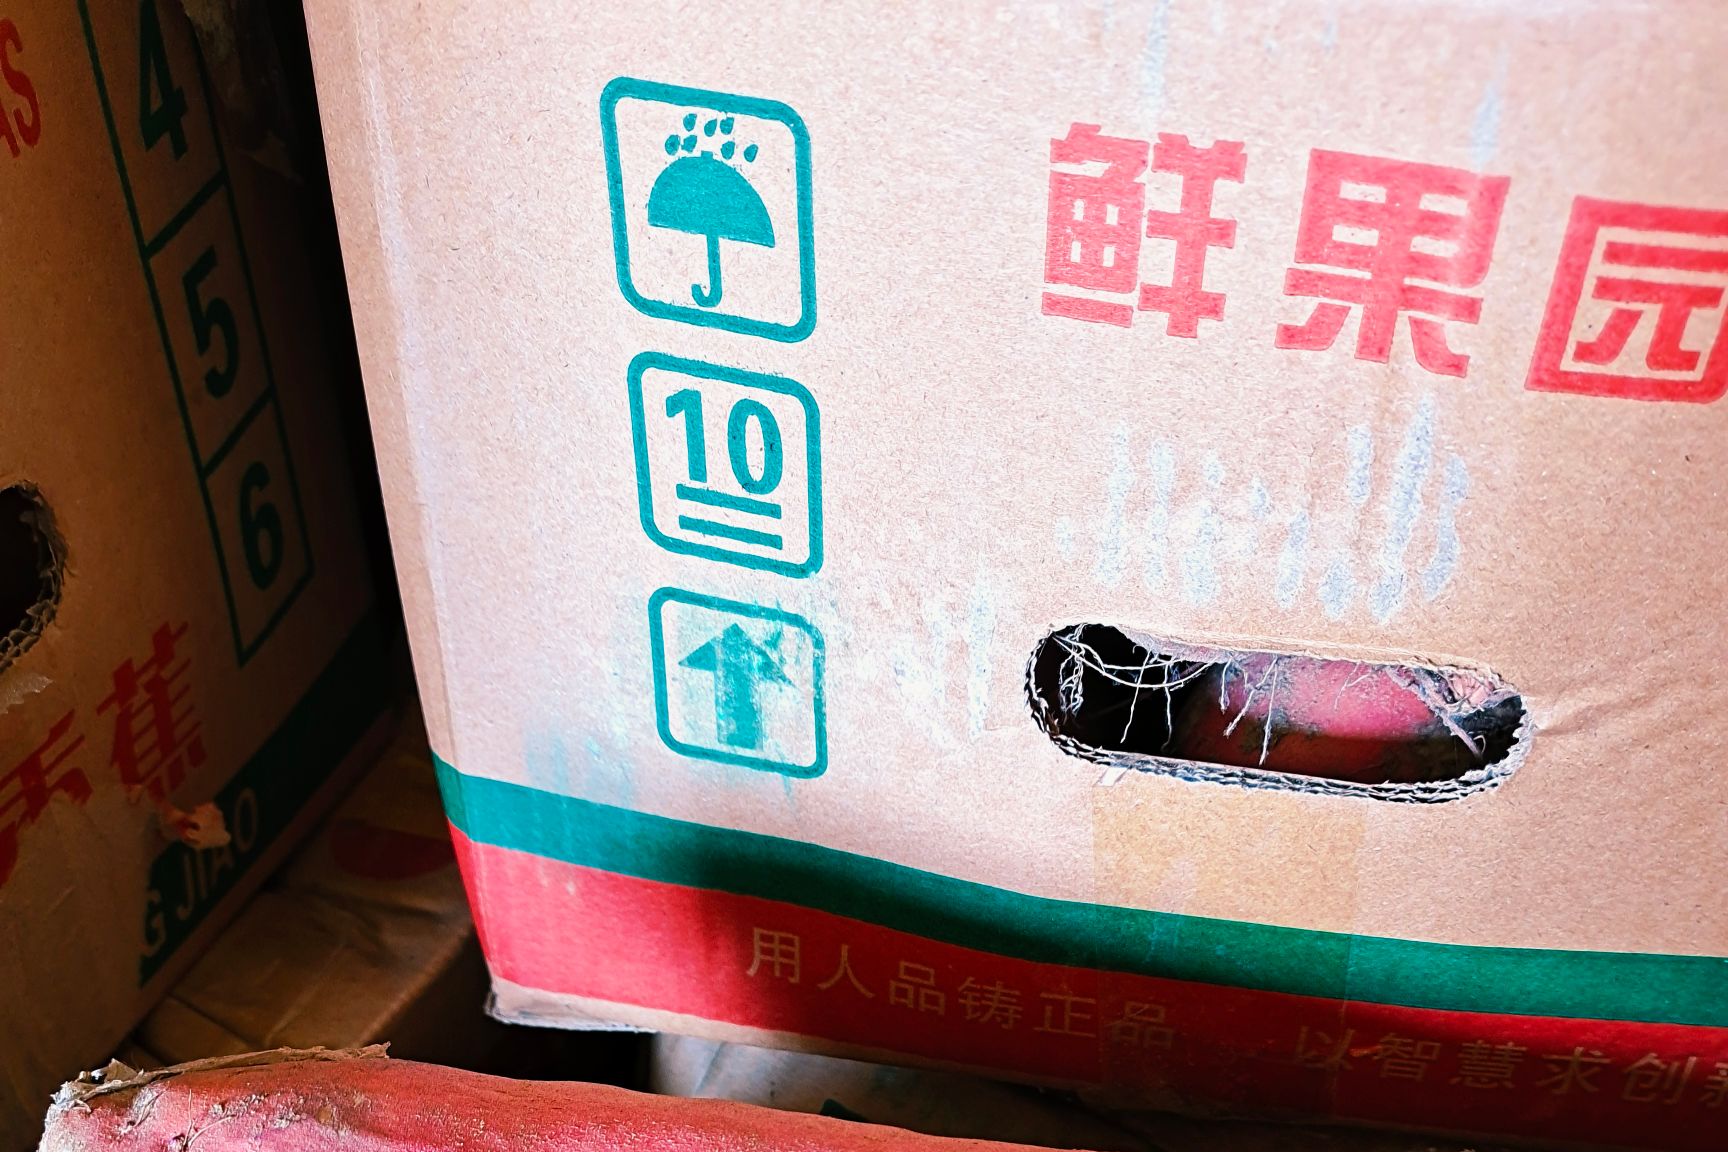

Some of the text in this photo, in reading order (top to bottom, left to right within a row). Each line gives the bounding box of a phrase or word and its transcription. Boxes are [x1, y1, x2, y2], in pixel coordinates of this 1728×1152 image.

[138, 0, 189, 161] 4
[181, 245, 240, 400] 5
[1041, 121, 1728, 404] 鲜果园
[665, 388, 783, 495] 10
[239, 460, 286, 591] 6
[745, 925, 1178, 1049] 用人品铸正品
